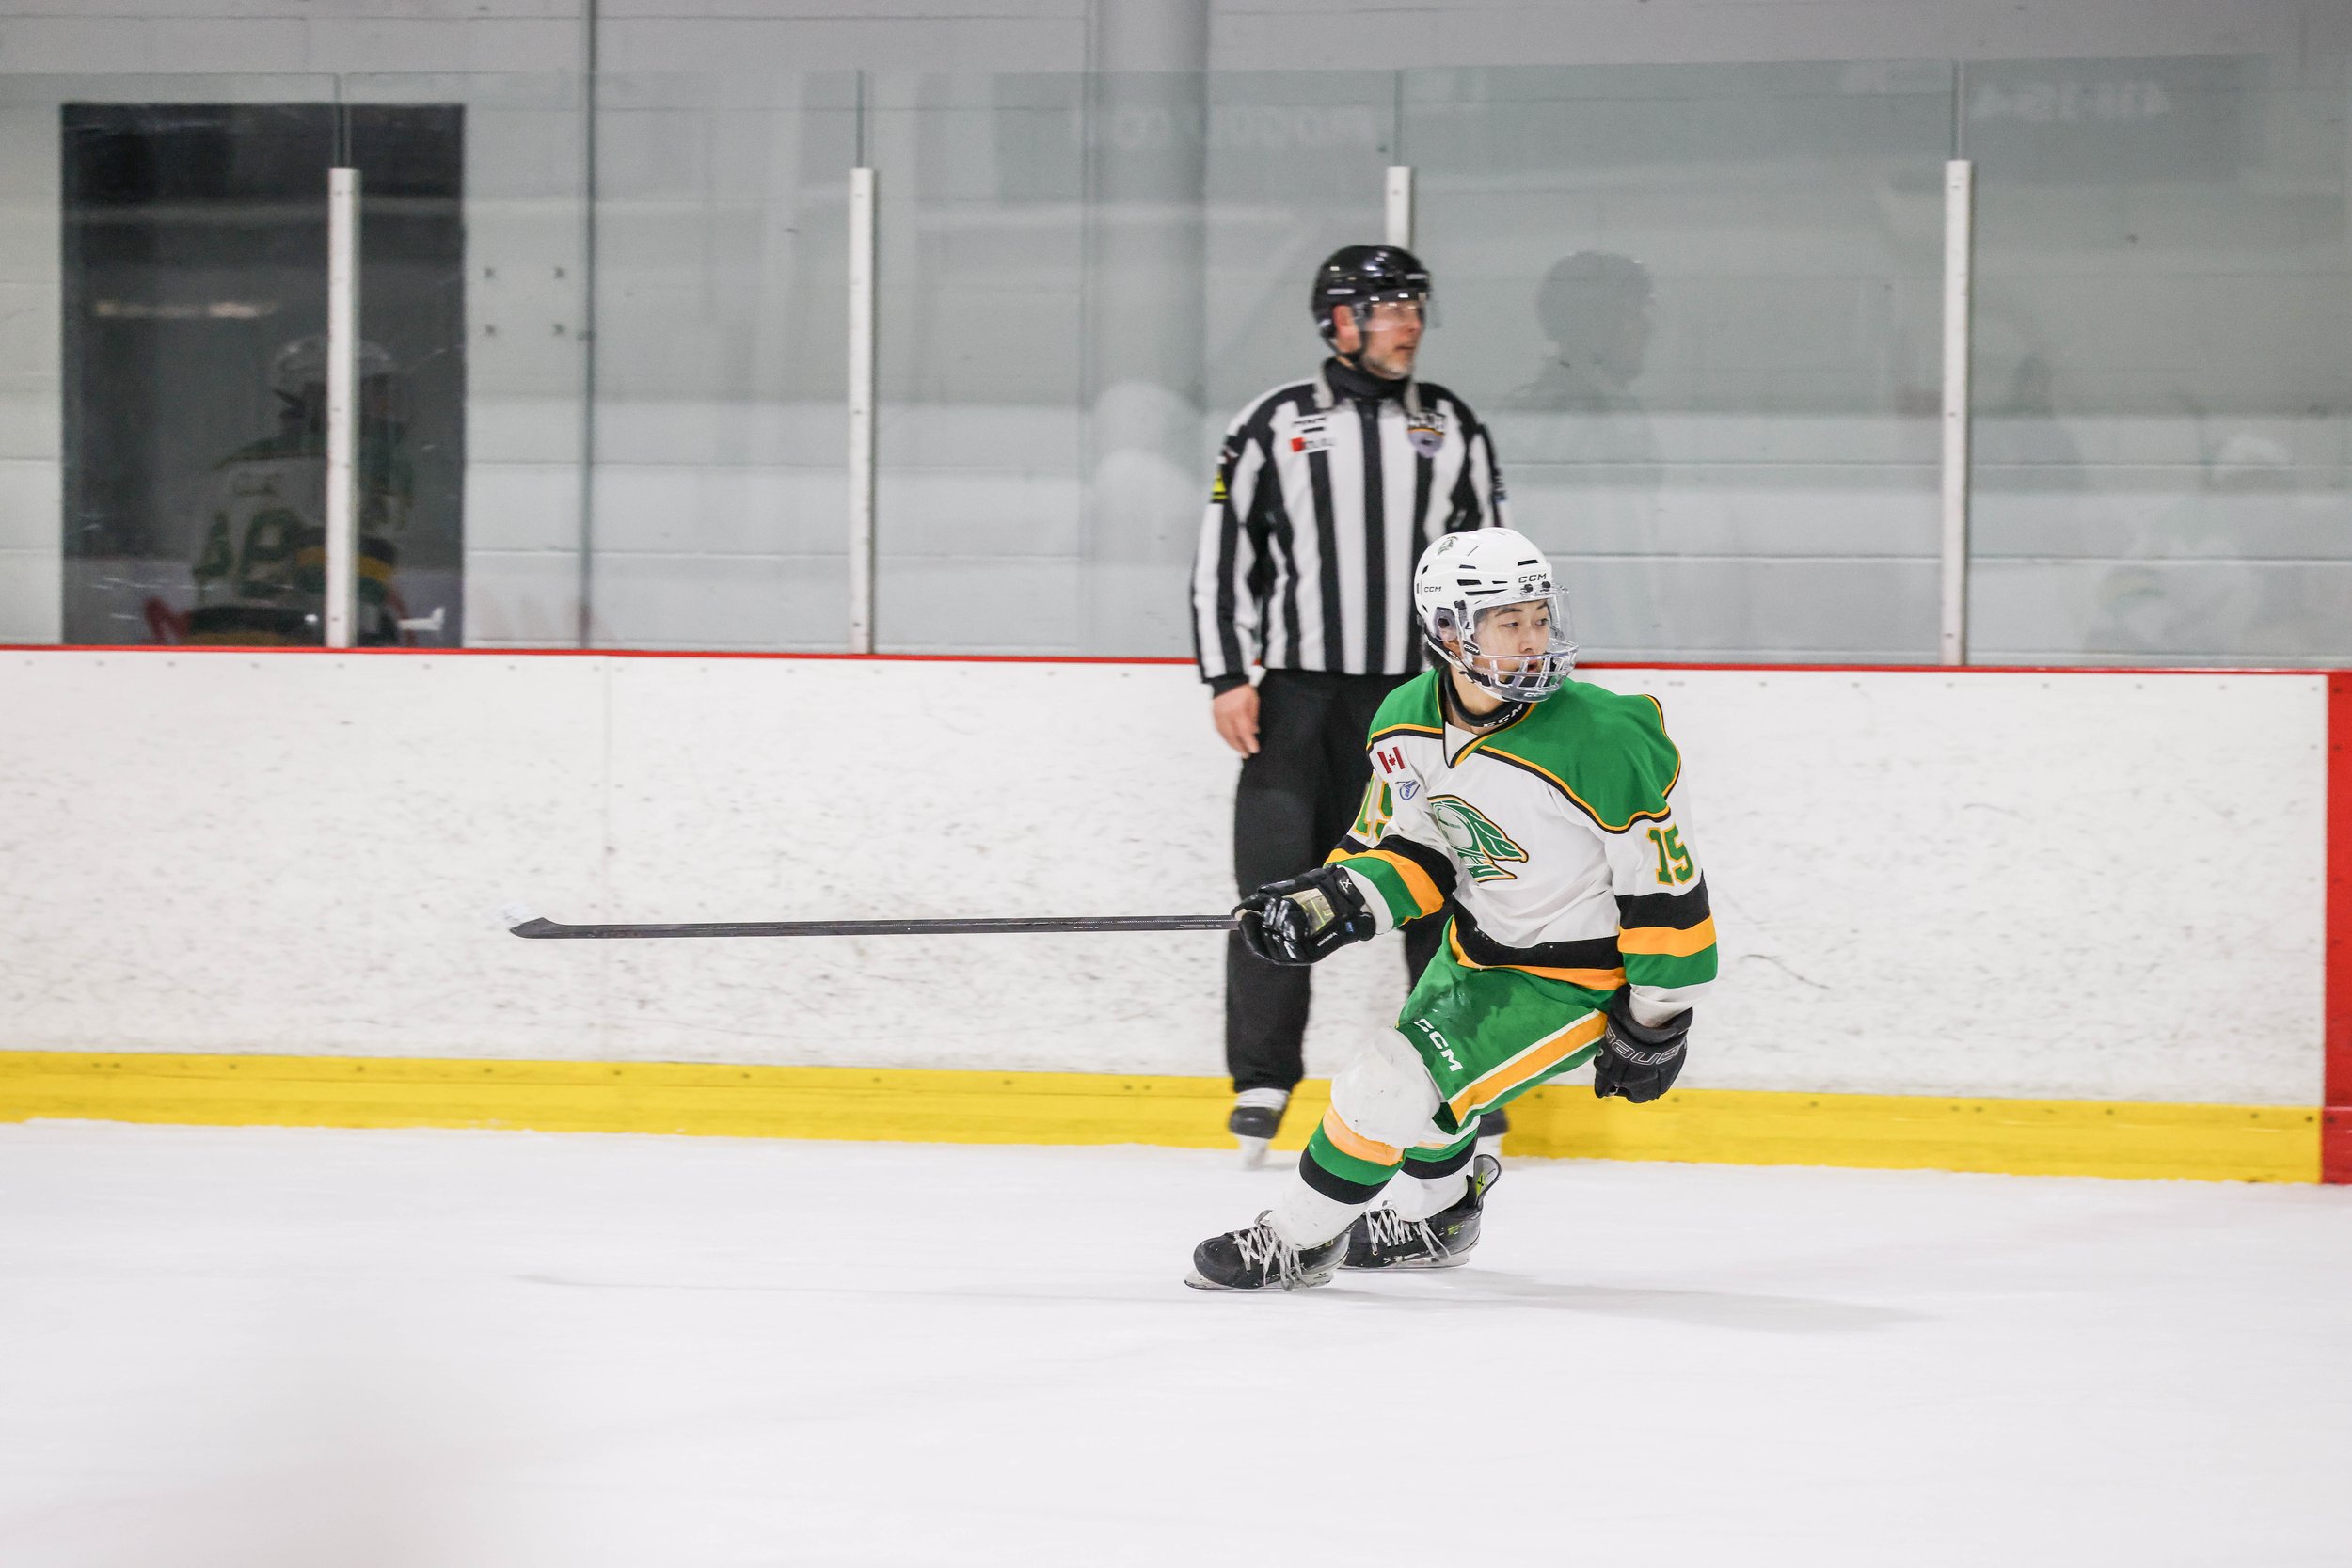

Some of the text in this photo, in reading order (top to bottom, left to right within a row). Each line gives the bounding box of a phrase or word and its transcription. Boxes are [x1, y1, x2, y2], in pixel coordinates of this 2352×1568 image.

[1518, 573, 1547, 584] CCM
[1483, 703, 1523, 728] CCM
[1646, 822, 1694, 887] 15
[1413, 1018, 1464, 1072] CCM
